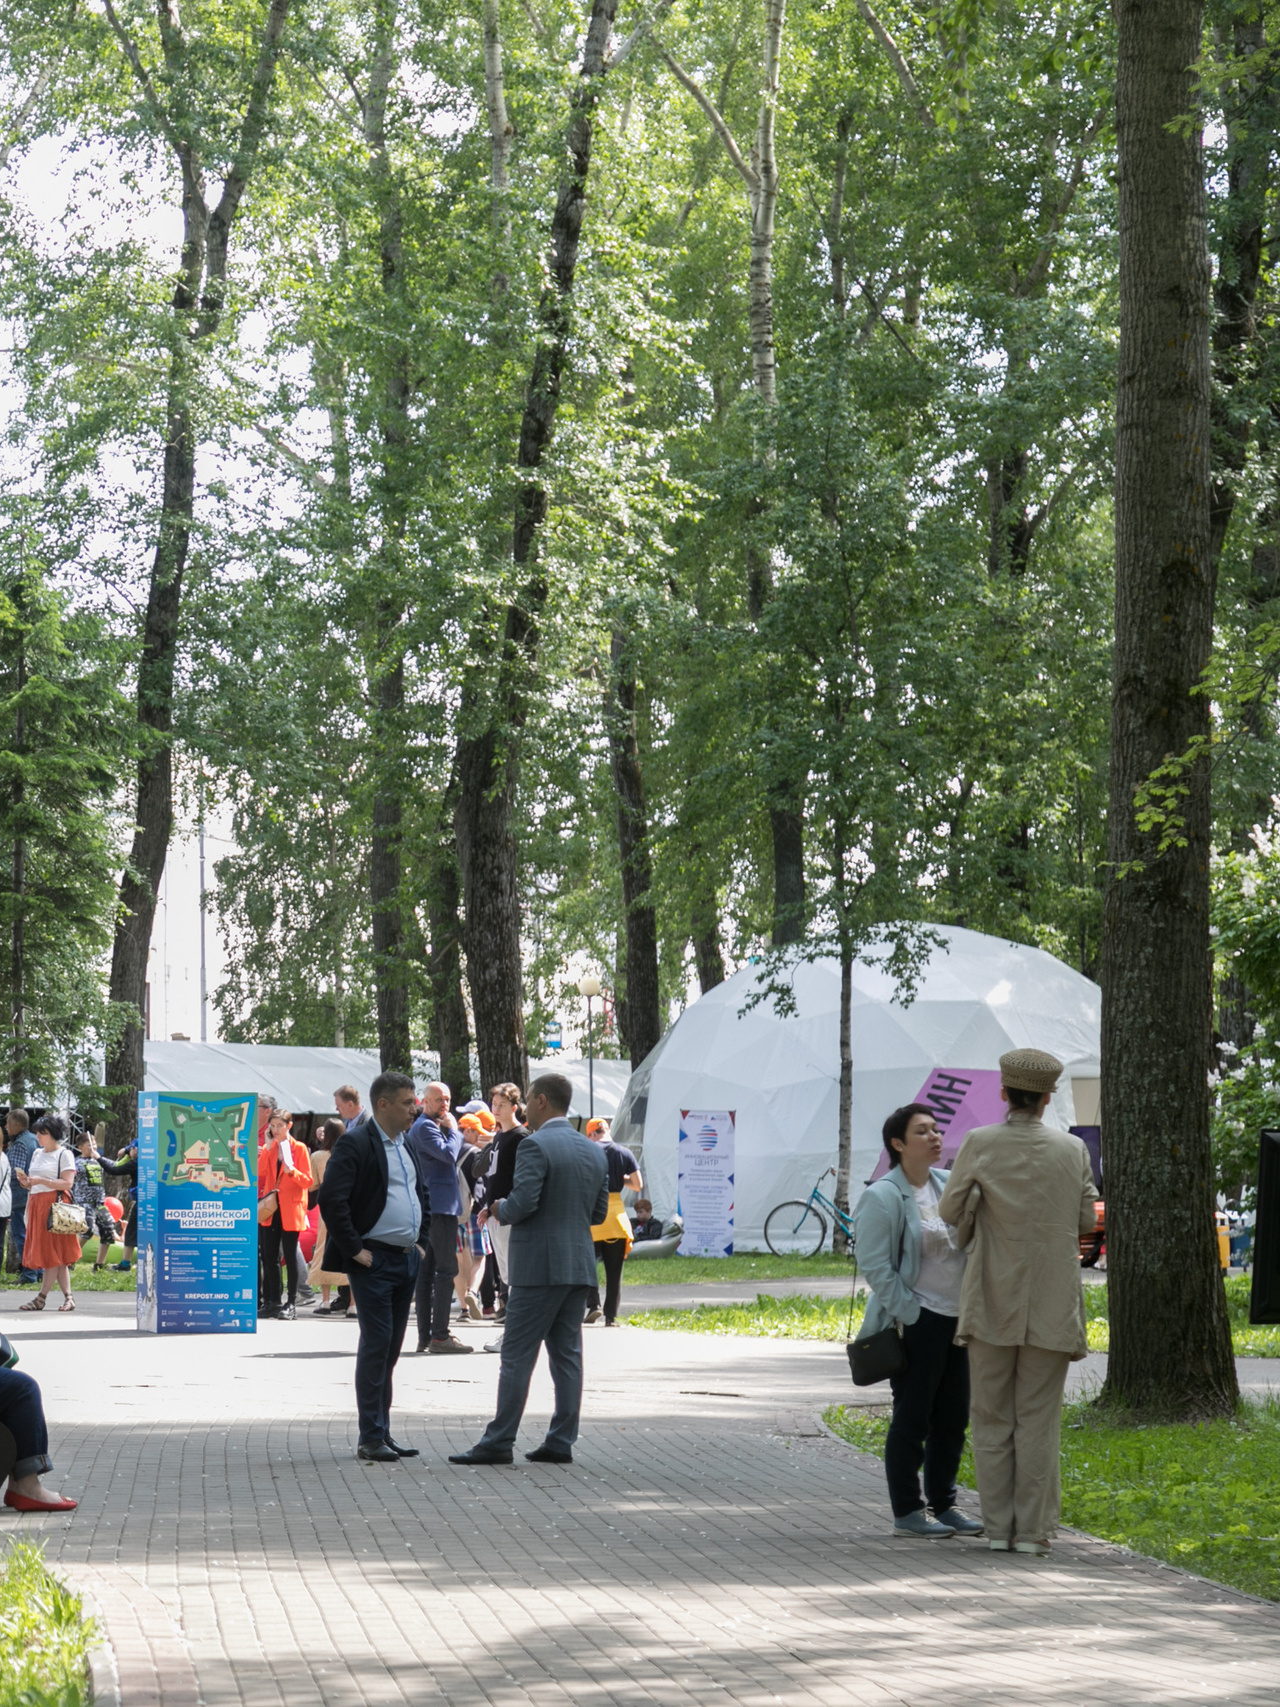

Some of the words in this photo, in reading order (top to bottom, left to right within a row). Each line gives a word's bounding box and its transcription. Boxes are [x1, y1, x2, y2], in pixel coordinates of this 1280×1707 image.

[194, 1202, 221, 1210] ДЕНЬ
[166, 1210, 249, 1219] НОВОДВИНСКОЙ
[182, 1219, 234, 1227] КРЕПОСТИ
